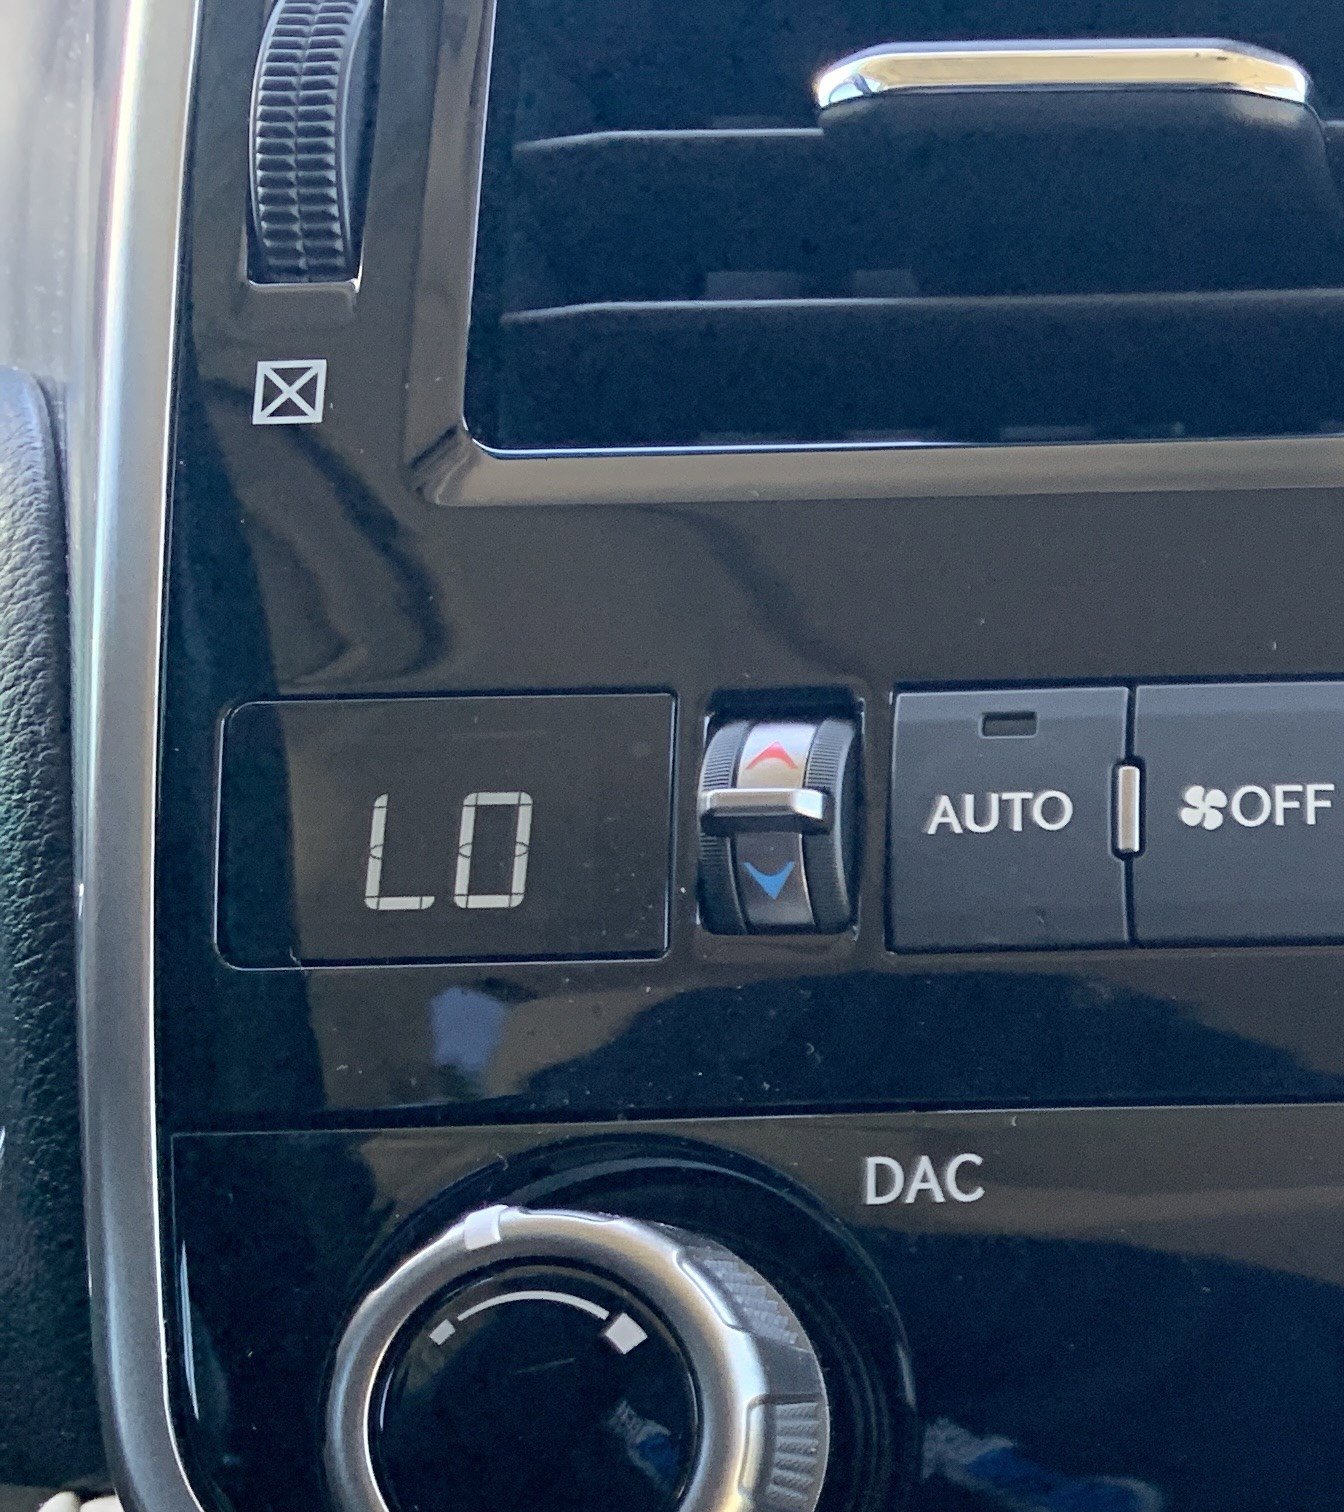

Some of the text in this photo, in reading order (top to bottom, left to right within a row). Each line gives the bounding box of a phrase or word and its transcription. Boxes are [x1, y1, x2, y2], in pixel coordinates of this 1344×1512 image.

[927, 790, 1073, 835] AUTO
[1230, 783, 1335, 827] OFF
[865, 1153, 985, 1205] DAC
